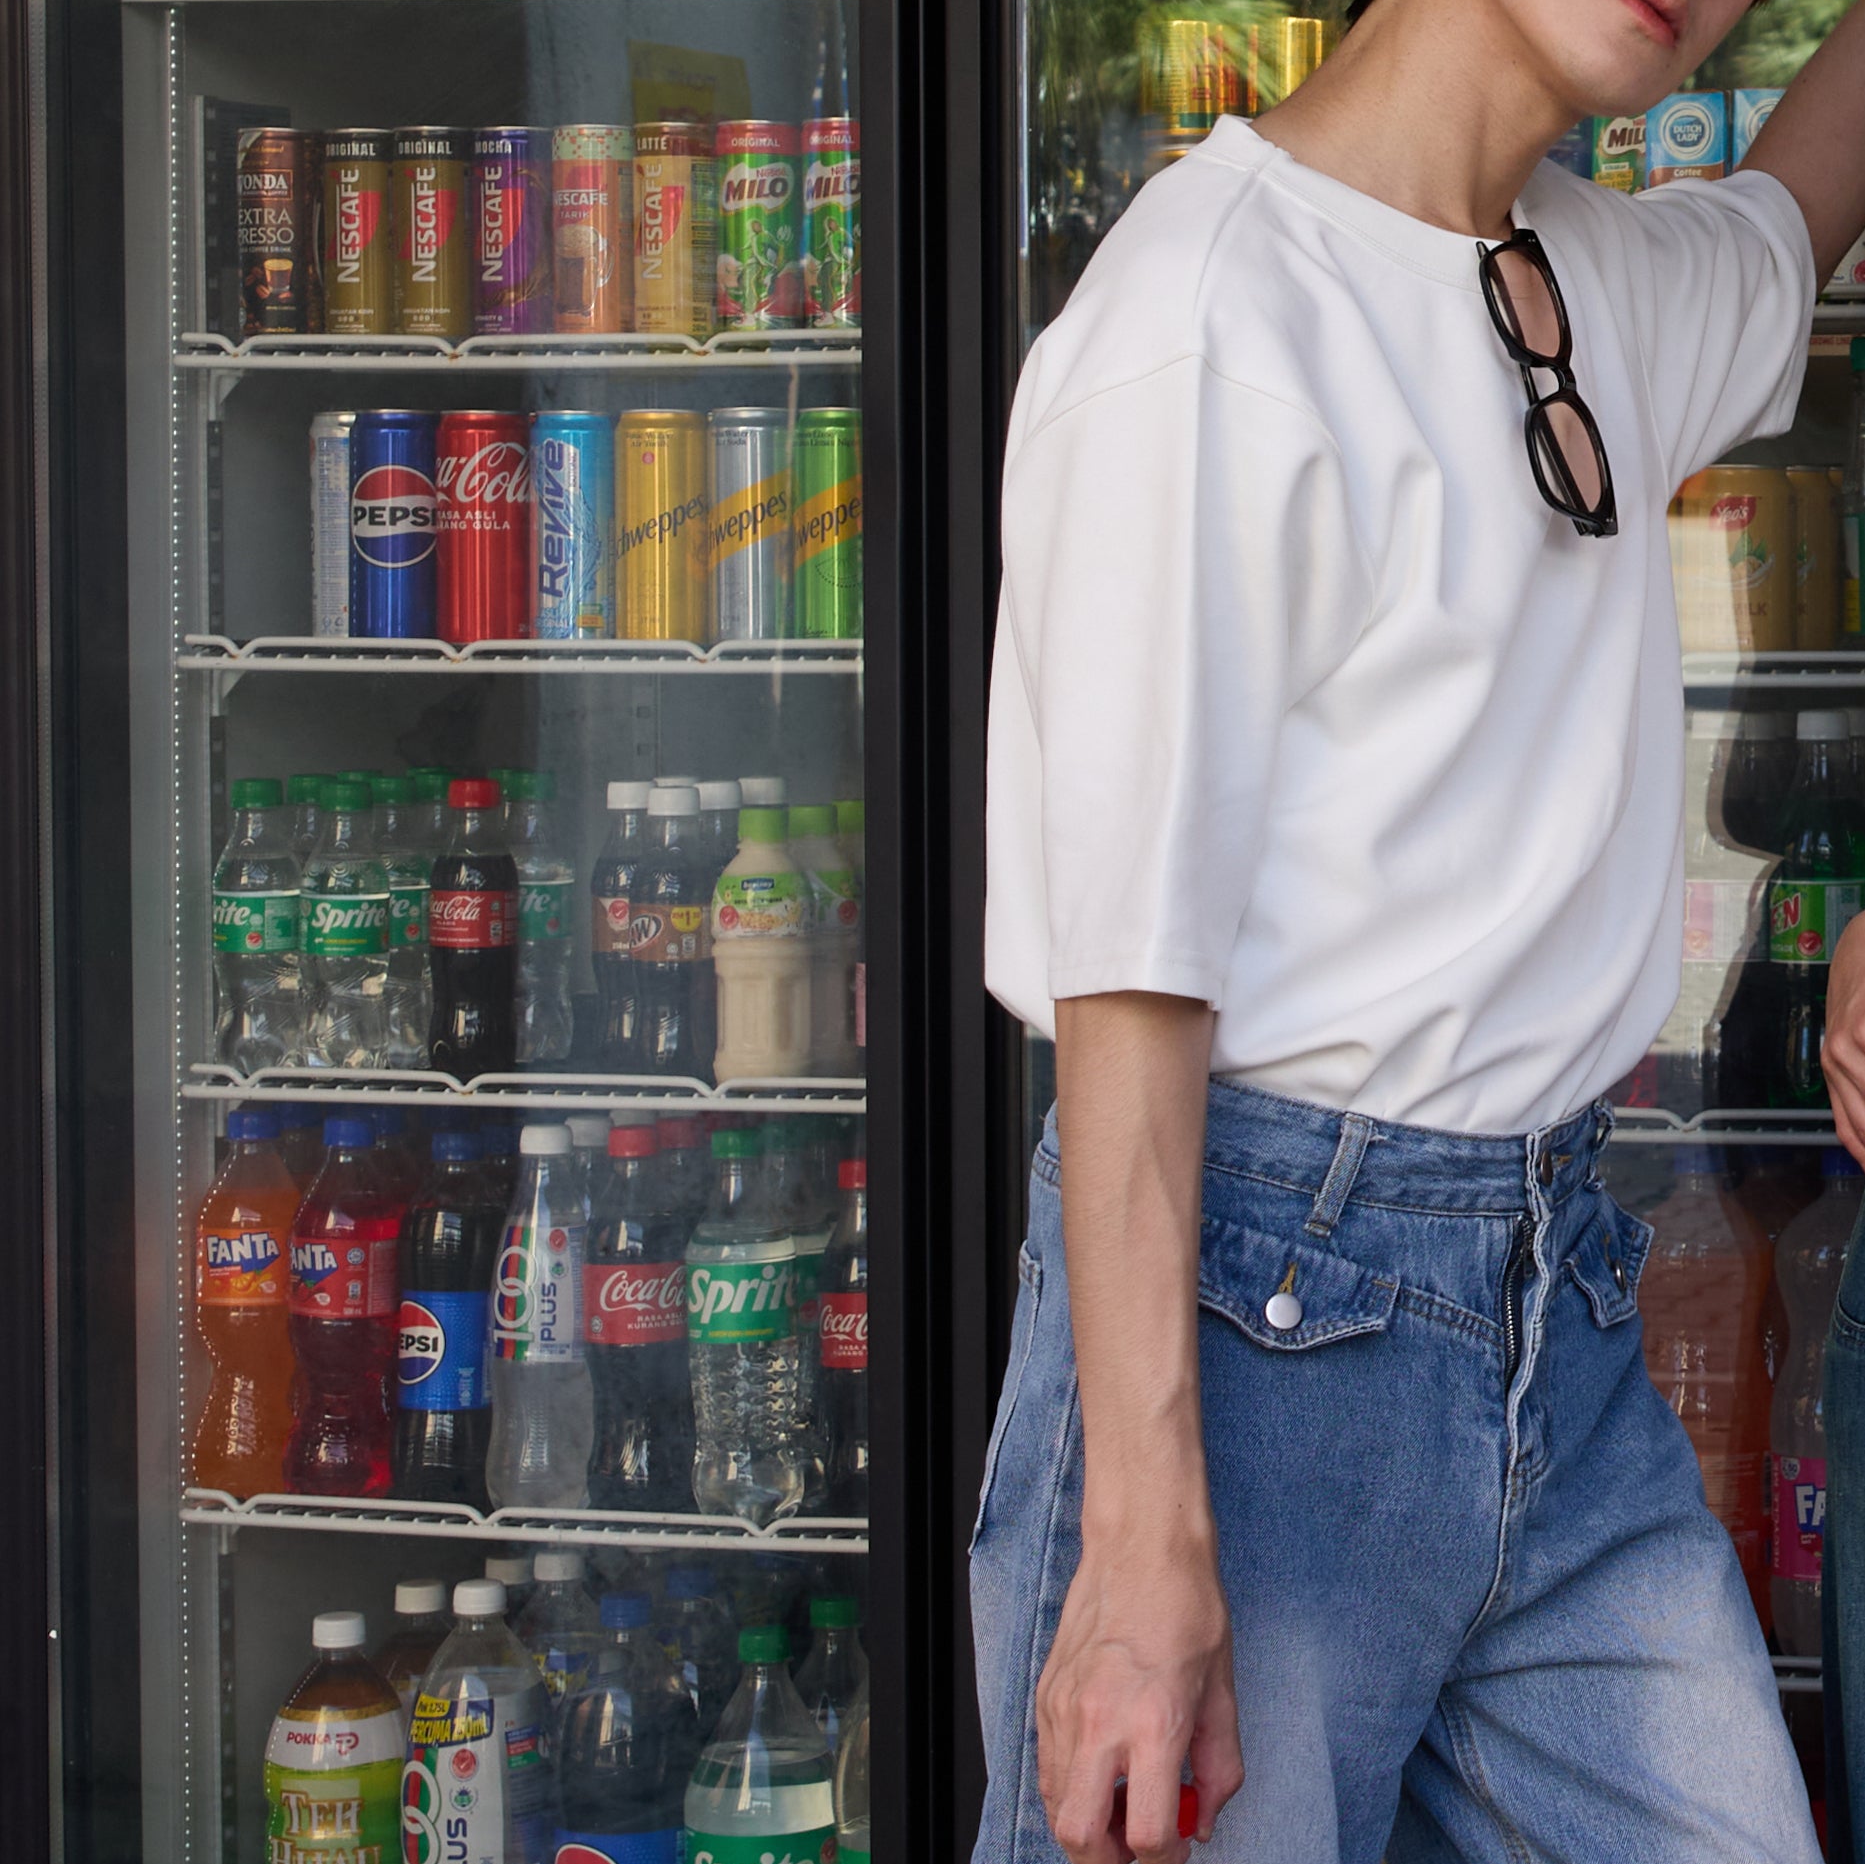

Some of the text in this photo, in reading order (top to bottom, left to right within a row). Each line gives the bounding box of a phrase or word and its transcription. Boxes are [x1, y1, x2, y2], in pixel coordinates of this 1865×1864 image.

[1673, 125, 1702, 135] DUTCH
[1676, 133, 1700, 142] LADY
[326, 142, 377, 157] ORIGINAL
[398, 141, 453, 156] ORIGINAL
[474, 138, 513, 155] MOCHA
[636, 136, 668, 151] LATTE
[731, 137, 781, 148] ORIGINAL
[1673, 167, 1702, 178] Coffee
[725, 177, 790, 204] MILO
[239, 208, 293, 225] EXTRA
[353, 506, 437, 527] PEPSI
[465, 510, 496, 520] ASLI
[1717, 505, 1749, 523] Yeo's
[472, 521, 511, 531] GULA
[311, 902, 386, 933] Sprite
[206, 1232, 280, 1266] FANTA
[600, 1266, 686, 1312] Coca-Co
[540, 1282, 557, 1342] PLUS
[281, 1789, 364, 1837] TEH
